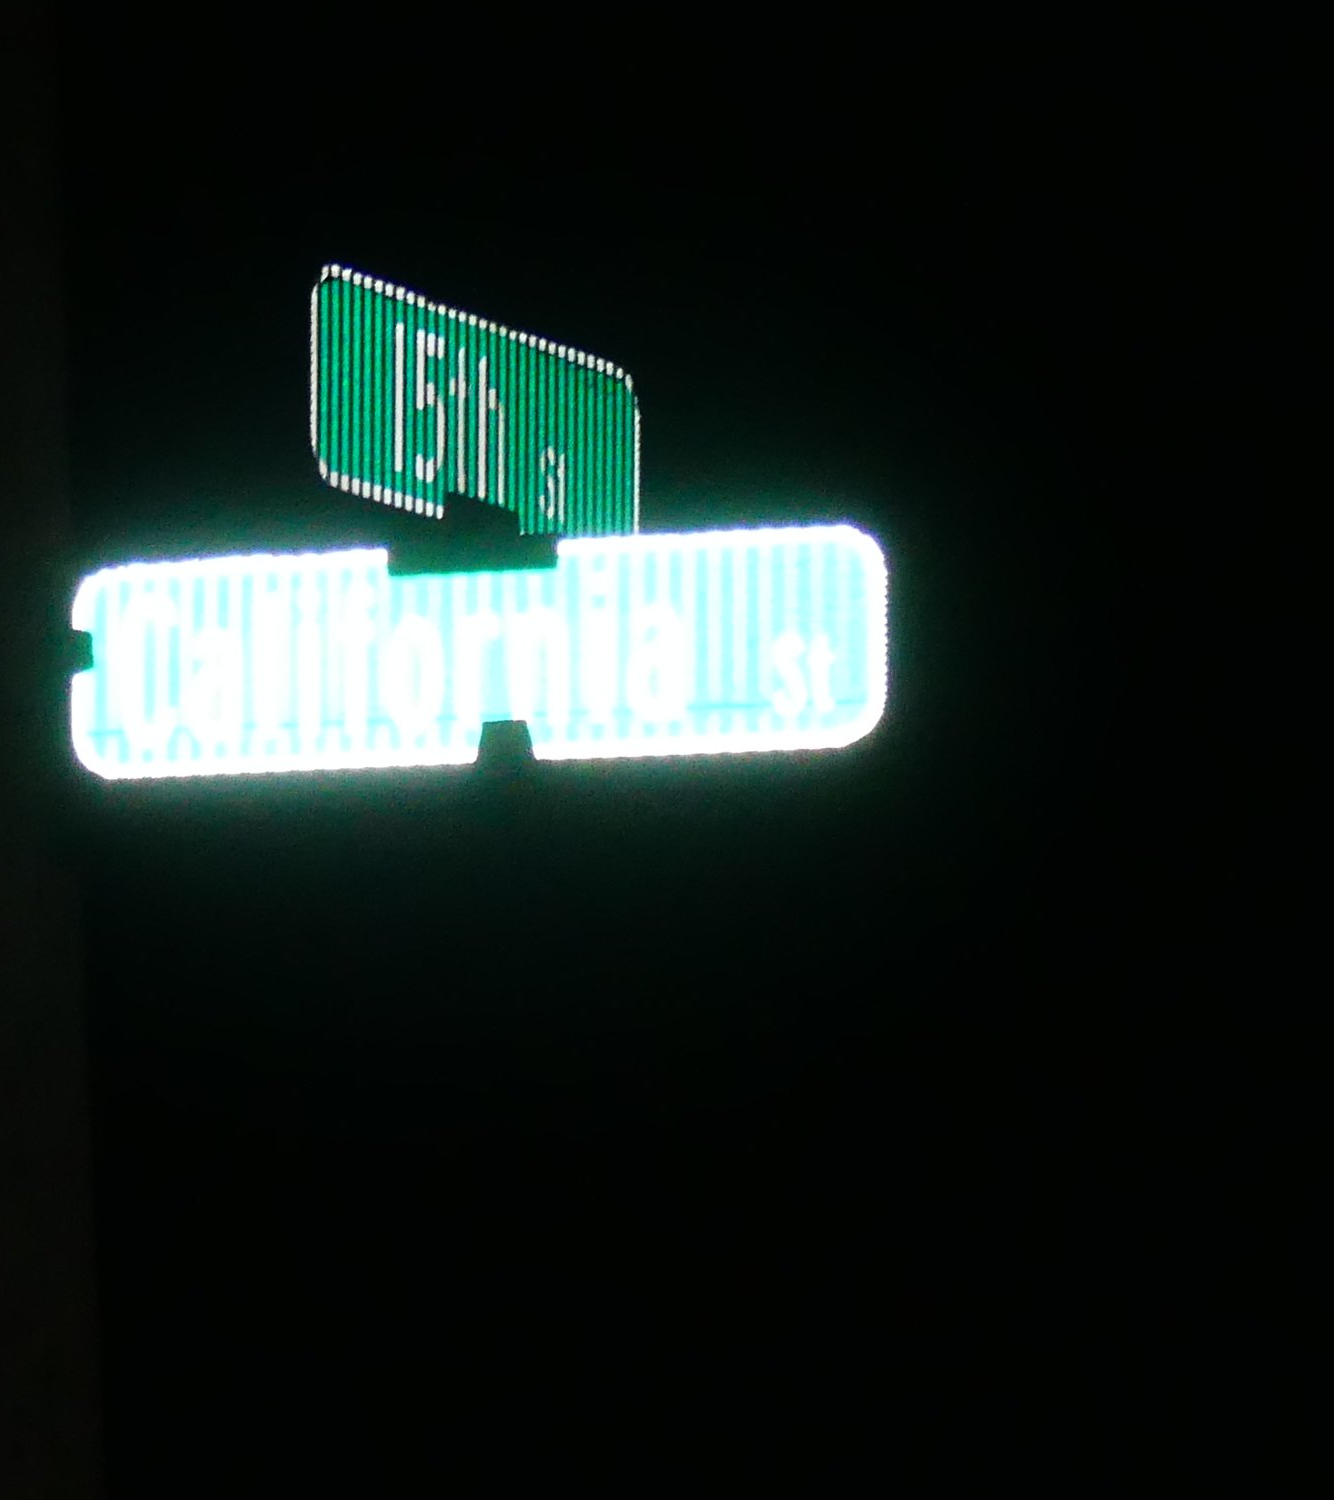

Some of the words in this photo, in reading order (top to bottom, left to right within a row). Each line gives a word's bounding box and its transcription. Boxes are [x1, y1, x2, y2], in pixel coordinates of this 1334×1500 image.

[394, 322, 505, 508] 15th
[120, 574, 691, 744] California
[770, 628, 837, 717] St
